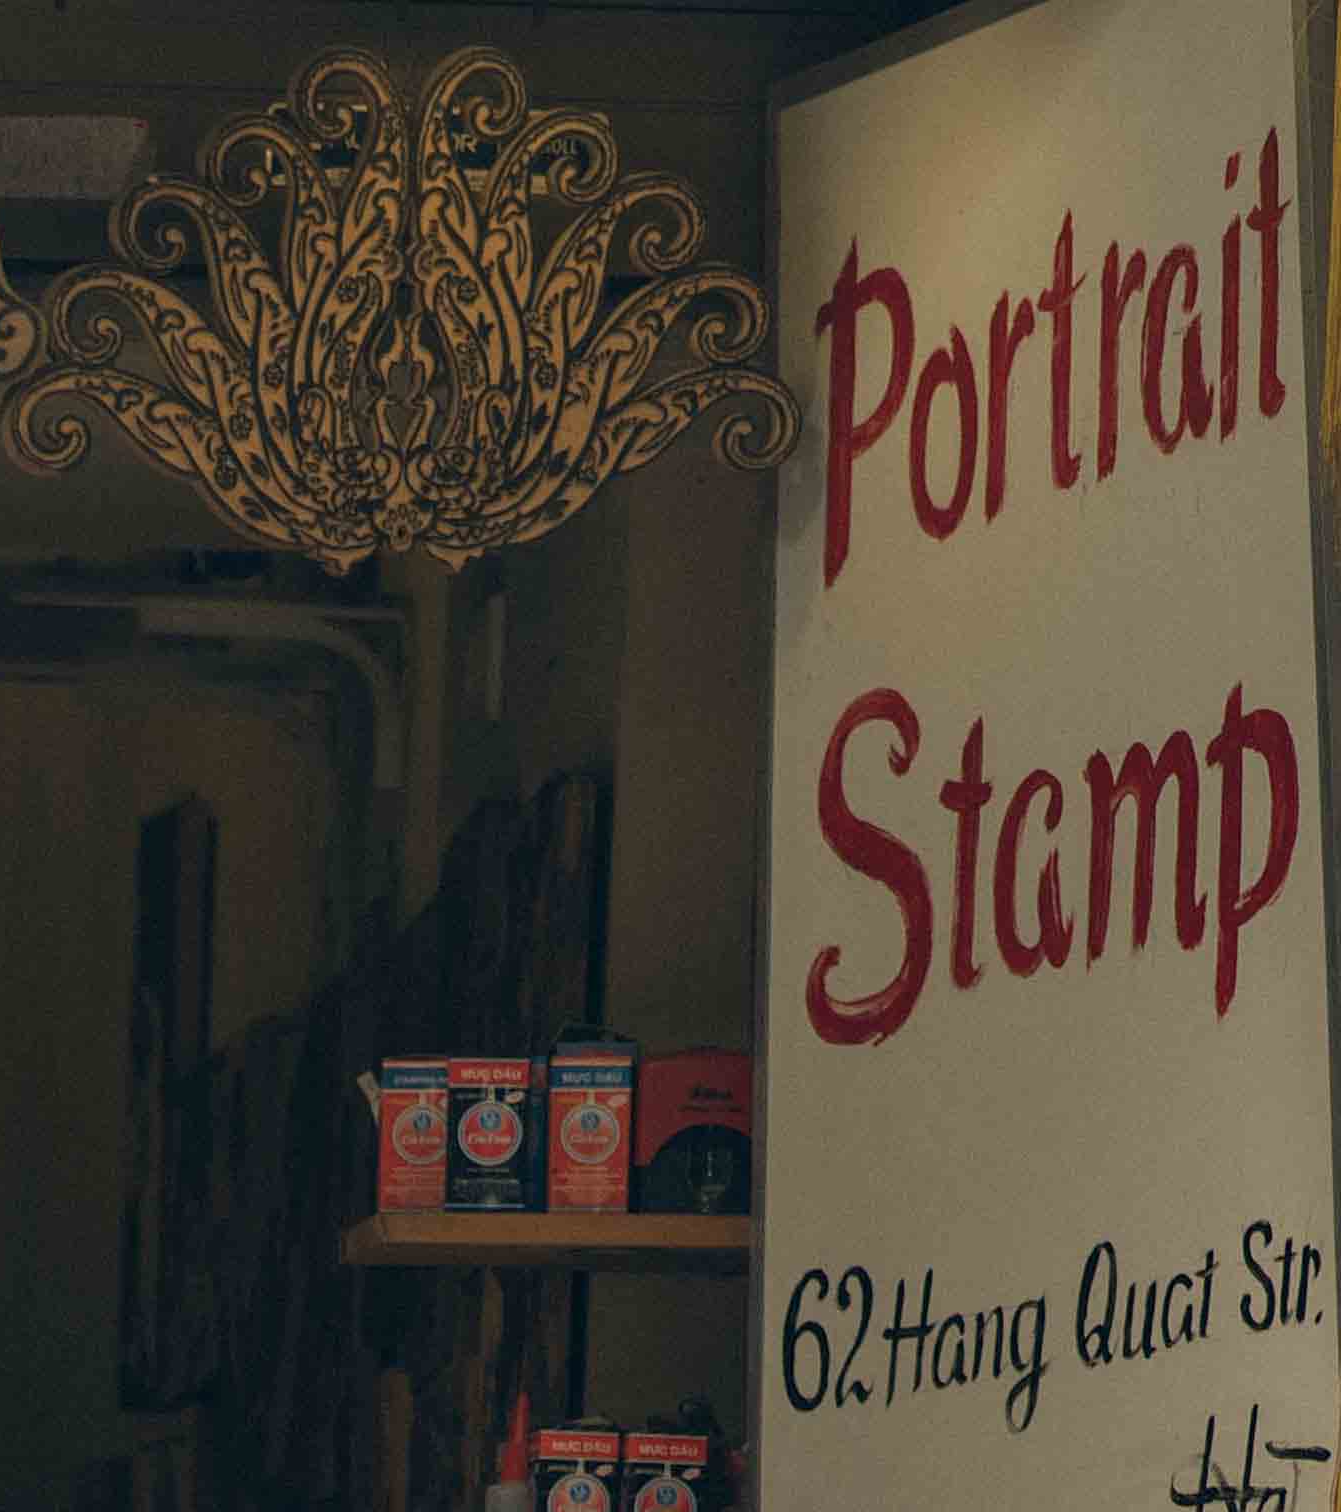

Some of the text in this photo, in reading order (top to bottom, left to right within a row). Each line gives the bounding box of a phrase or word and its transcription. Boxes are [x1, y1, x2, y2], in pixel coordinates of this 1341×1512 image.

[817, 126, 1291, 588] Portrait
[805, 682, 1301, 1046] Stamp
[1239, 1219, 1325, 1332] Str.
